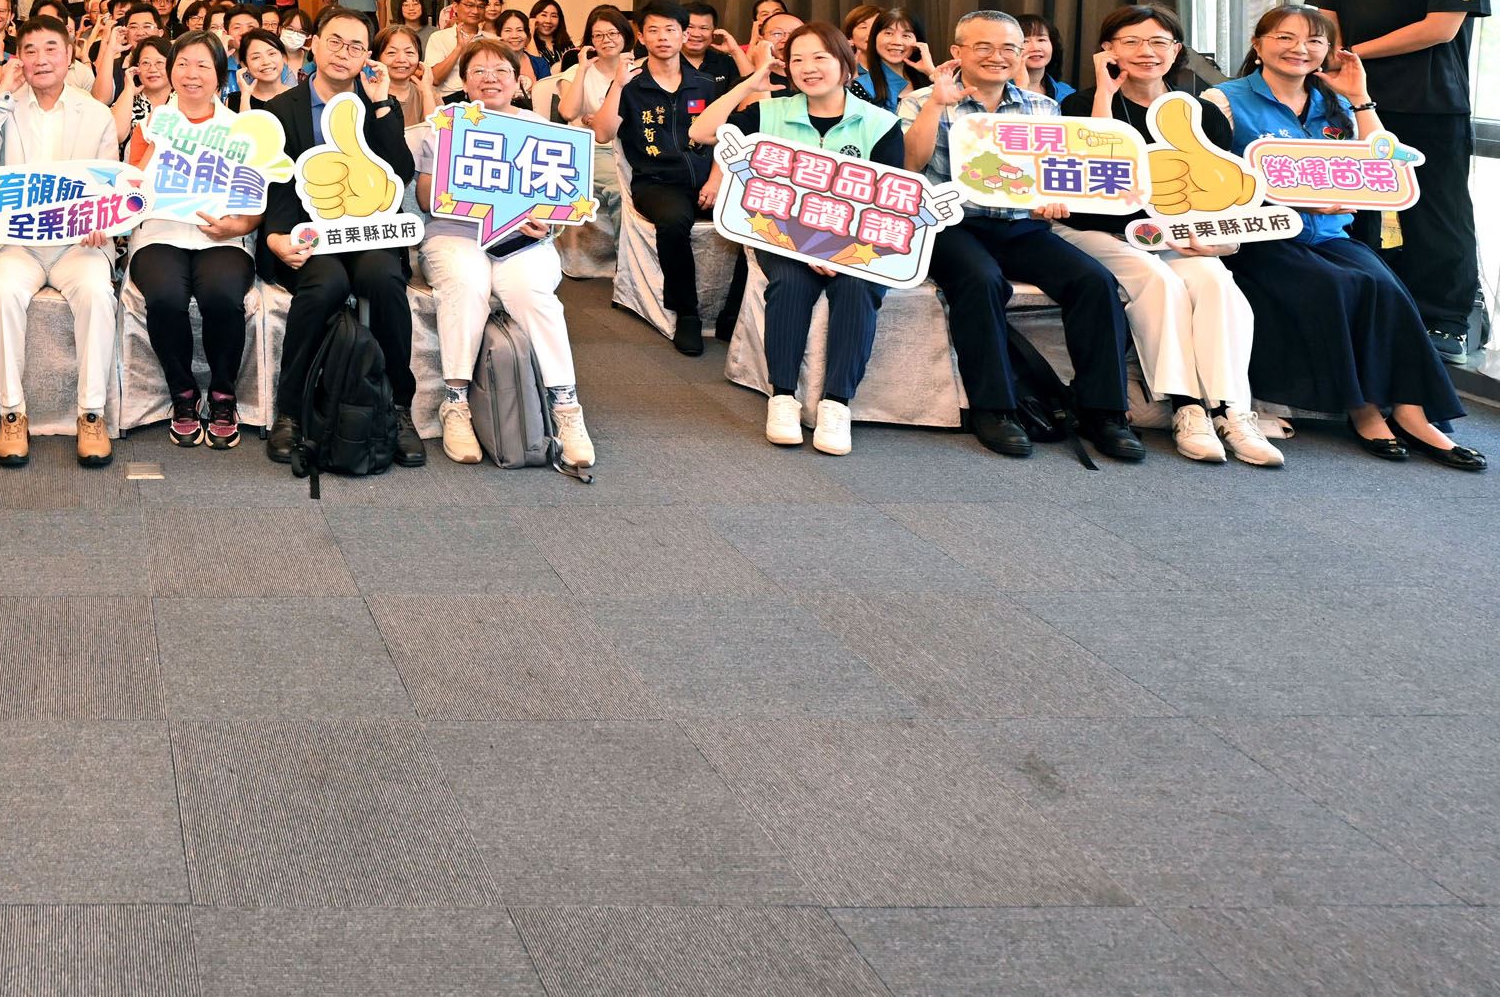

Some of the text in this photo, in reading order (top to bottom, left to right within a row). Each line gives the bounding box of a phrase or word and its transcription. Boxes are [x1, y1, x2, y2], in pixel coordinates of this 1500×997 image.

[997, 124, 1066, 153] 看見
[153, 150, 267, 209] 超能量
[452, 128, 579, 202] 品保
[753, 143, 918, 212] 學習品保
[1041, 157, 1132, 195] 苗栗
[1262, 155, 1399, 192] 榮耀苗栗
[6, 193, 133, 242] 全栗綻放
[325, 221, 417, 246] 苗栗縣政府
[746, 180, 909, 251] 讚讚讚
[1168, 213, 1291, 241] 苗栗縣政府
